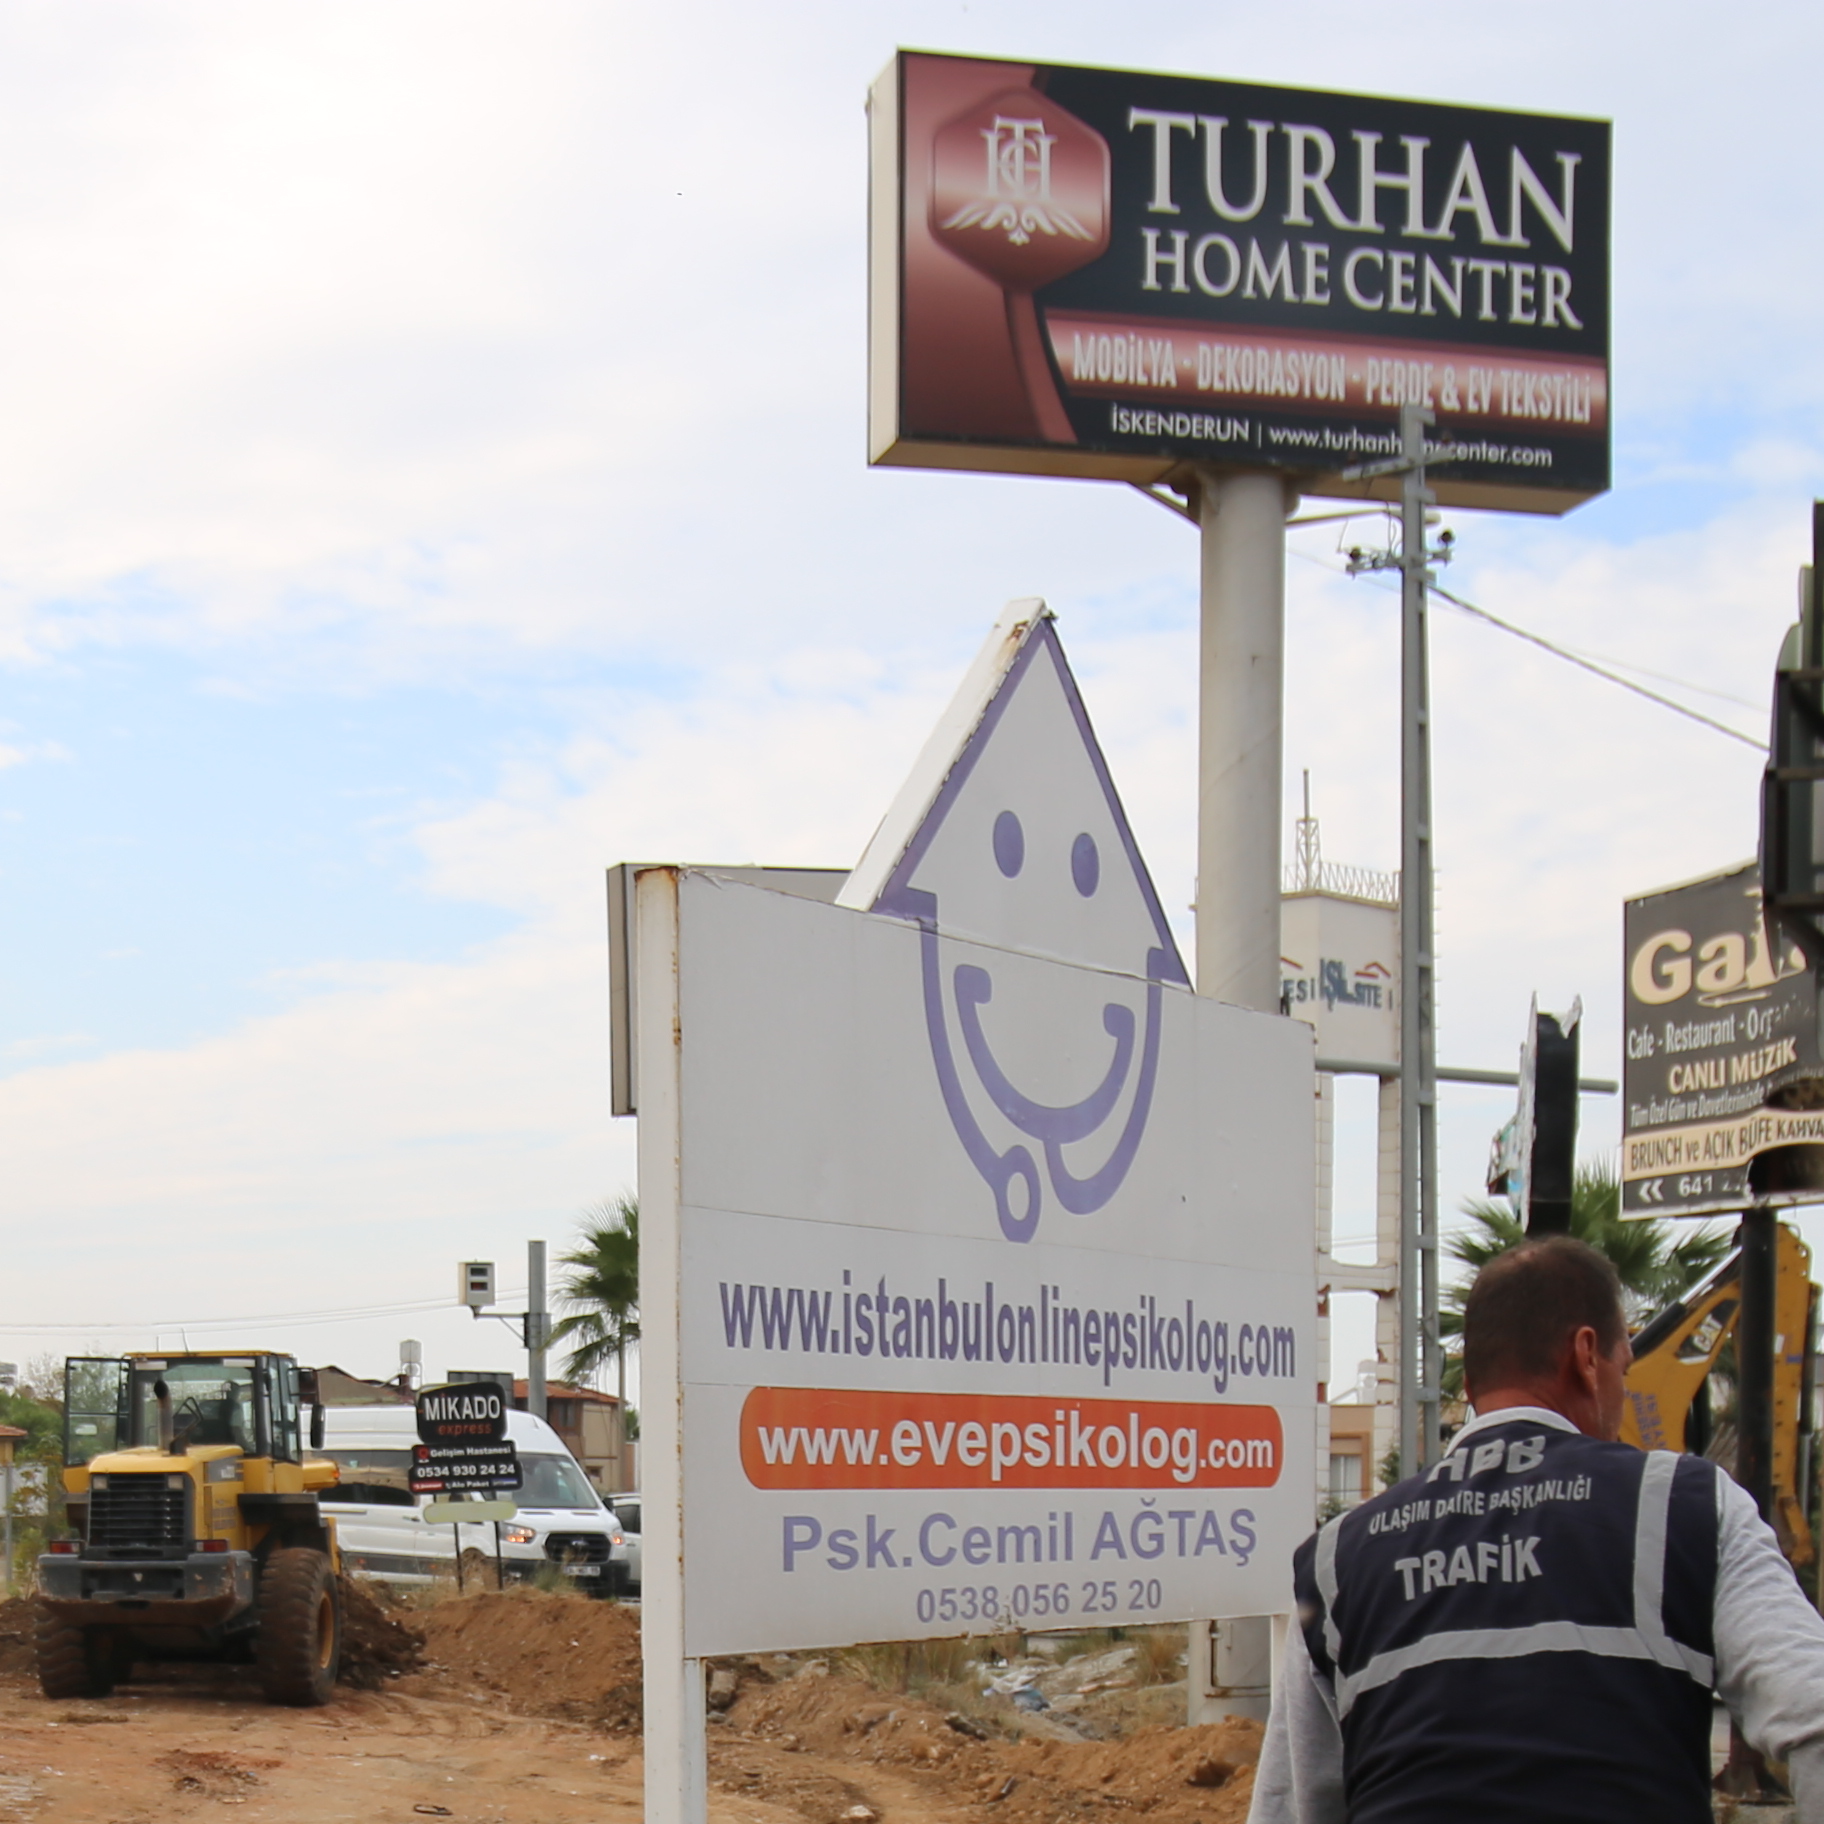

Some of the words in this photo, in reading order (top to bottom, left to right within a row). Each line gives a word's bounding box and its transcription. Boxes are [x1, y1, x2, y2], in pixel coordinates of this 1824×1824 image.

[1128, 105, 1582, 255] TURHAN
[1140, 226, 1332, 306] HOME
[1343, 246, 1584, 331] CENTER
[1073, 331, 1178, 388] MOBİLYA
[1196, 342, 1347, 402] DEKORASYON
[1365, 357, 1435, 410] PERDE
[1441, 364, 1461, 413] &
[1467, 365, 1494, 415] EV
[1500, 369, 1591, 425] TEKSTİLİ
[1111, 402, 1250, 442] İSKENDERUN
[1627, 1024, 1654, 1060] Cafe
[1665, 1013, 1736, 1056] Restaurant
[1668, 1058, 1727, 1094] CANLI
[1731, 1036, 1798, 1085] MÜZİK
[1631, 1135, 1683, 1173] BRUNCH
[1686, 1140, 1700, 1162] ve
[1703, 1128, 1735, 1166] AÇIK
[1739, 1115, 1773, 1156] BÜFE
[1679, 1173, 1714, 1198] 641
[719, 1269, 1295, 1394] www.istanbulonlinepsikolog.com
[1692, 1313, 1723, 1352] CAT
[430, 1447, 465, 1458] Gelişim
[466, 1445, 512, 1456] Hastanesi
[437, 1423, 493, 1436] express
[757, 1409, 1274, 1483] www.evepsikolog.com
[417, 1466, 450, 1478] 0534
[452, 1465, 477, 1476] 930
[480, 1464, 497, 1476] 24
[499, 1463, 516, 1475] 24
[1369, 1499, 1431, 1536] ULAŞIM
[1435, 1488, 1485, 1519] DAİRE
[1489, 1474, 1593, 1516] BAŞKANLIĞI
[781, 1511, 1074, 1572] Psk.Cemil
[1089, 1497, 1258, 1567] AĞTAŞ
[1394, 1533, 1543, 1601] TRAFİK
[916, 1583, 1001, 1623] 0538
[1012, 1582, 1071, 1617] 056
[1081, 1580, 1118, 1613] 25
[1128, 1577, 1163, 1610] 20
